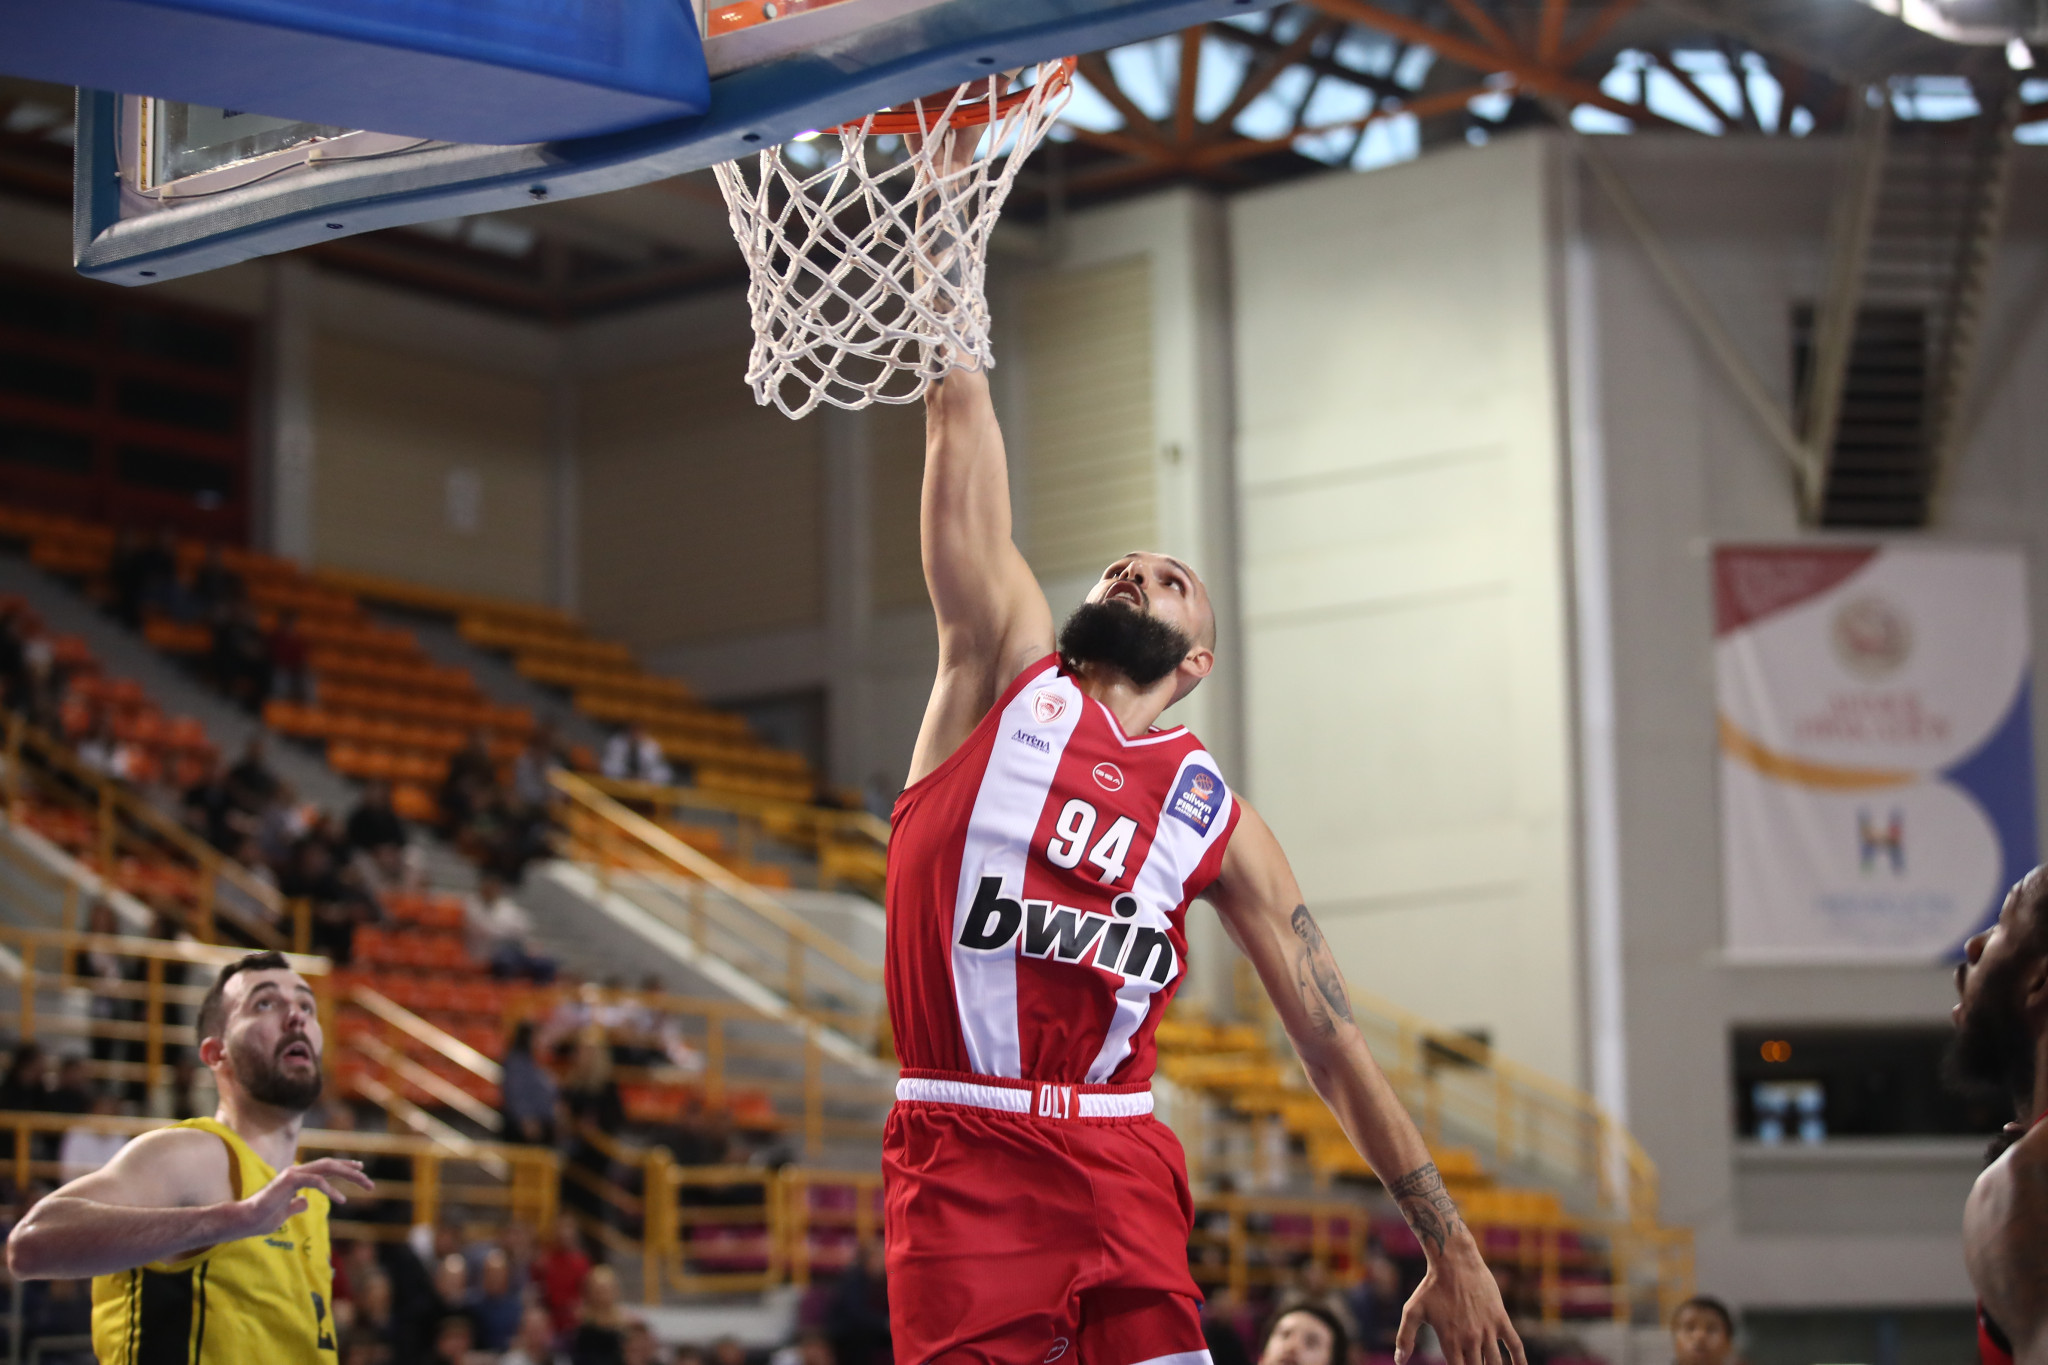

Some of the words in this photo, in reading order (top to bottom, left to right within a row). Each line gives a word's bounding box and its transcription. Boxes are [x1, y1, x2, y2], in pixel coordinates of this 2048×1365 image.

[1175, 797, 1203, 820] FINAL
[1182, 791, 1212, 815] allwyn
[1046, 797, 1139, 886] 94
[957, 875, 1174, 986] bwin
[1038, 1083, 1073, 1120] OLY
